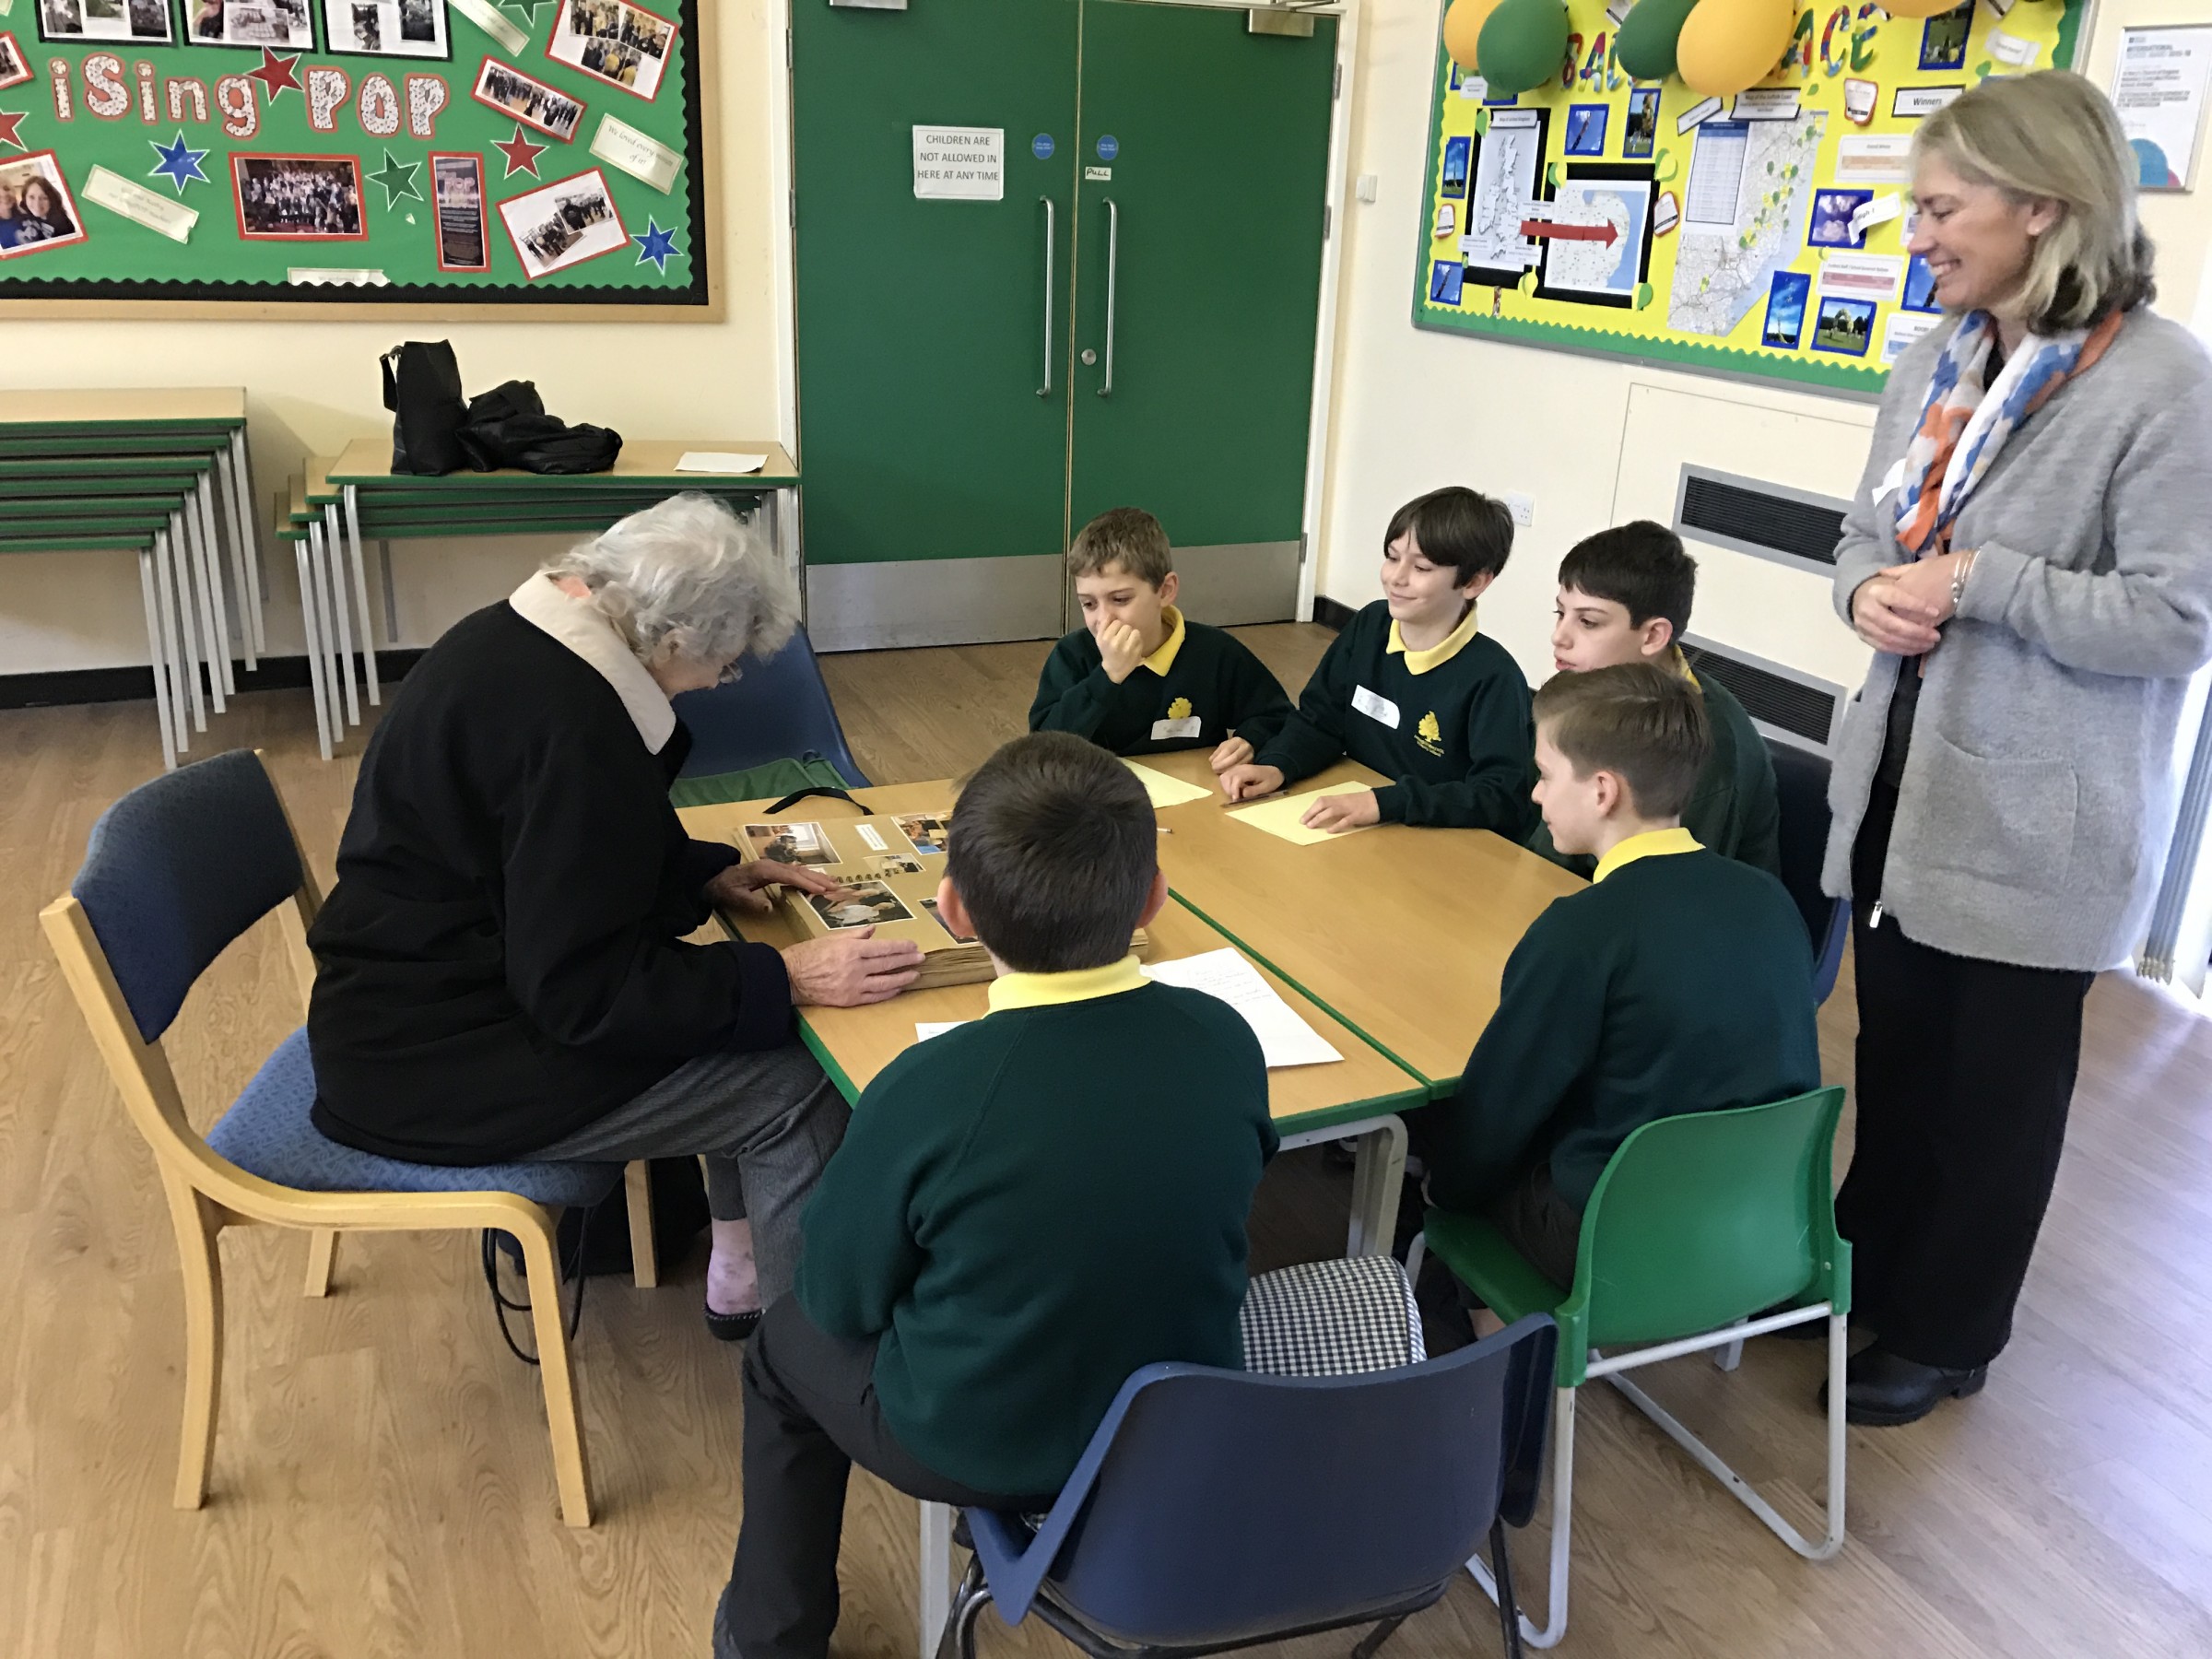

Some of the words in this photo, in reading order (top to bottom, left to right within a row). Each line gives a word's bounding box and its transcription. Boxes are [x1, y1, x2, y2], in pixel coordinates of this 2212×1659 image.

[1767, 2, 1888, 79] ACE
[1913, 98, 1942, 106] Winners
[925, 135, 971, 145] CHILDREN
[973, 136, 990, 146] ARE
[920, 152, 939, 161] NOT
[941, 153, 985, 163] ALLOWED
[987, 155, 997, 163] IN
[917, 170, 940, 179] HERE
[943, 171, 954, 179] AT
[956, 171, 974, 180] ANY
[977, 171, 999, 181] TIME
